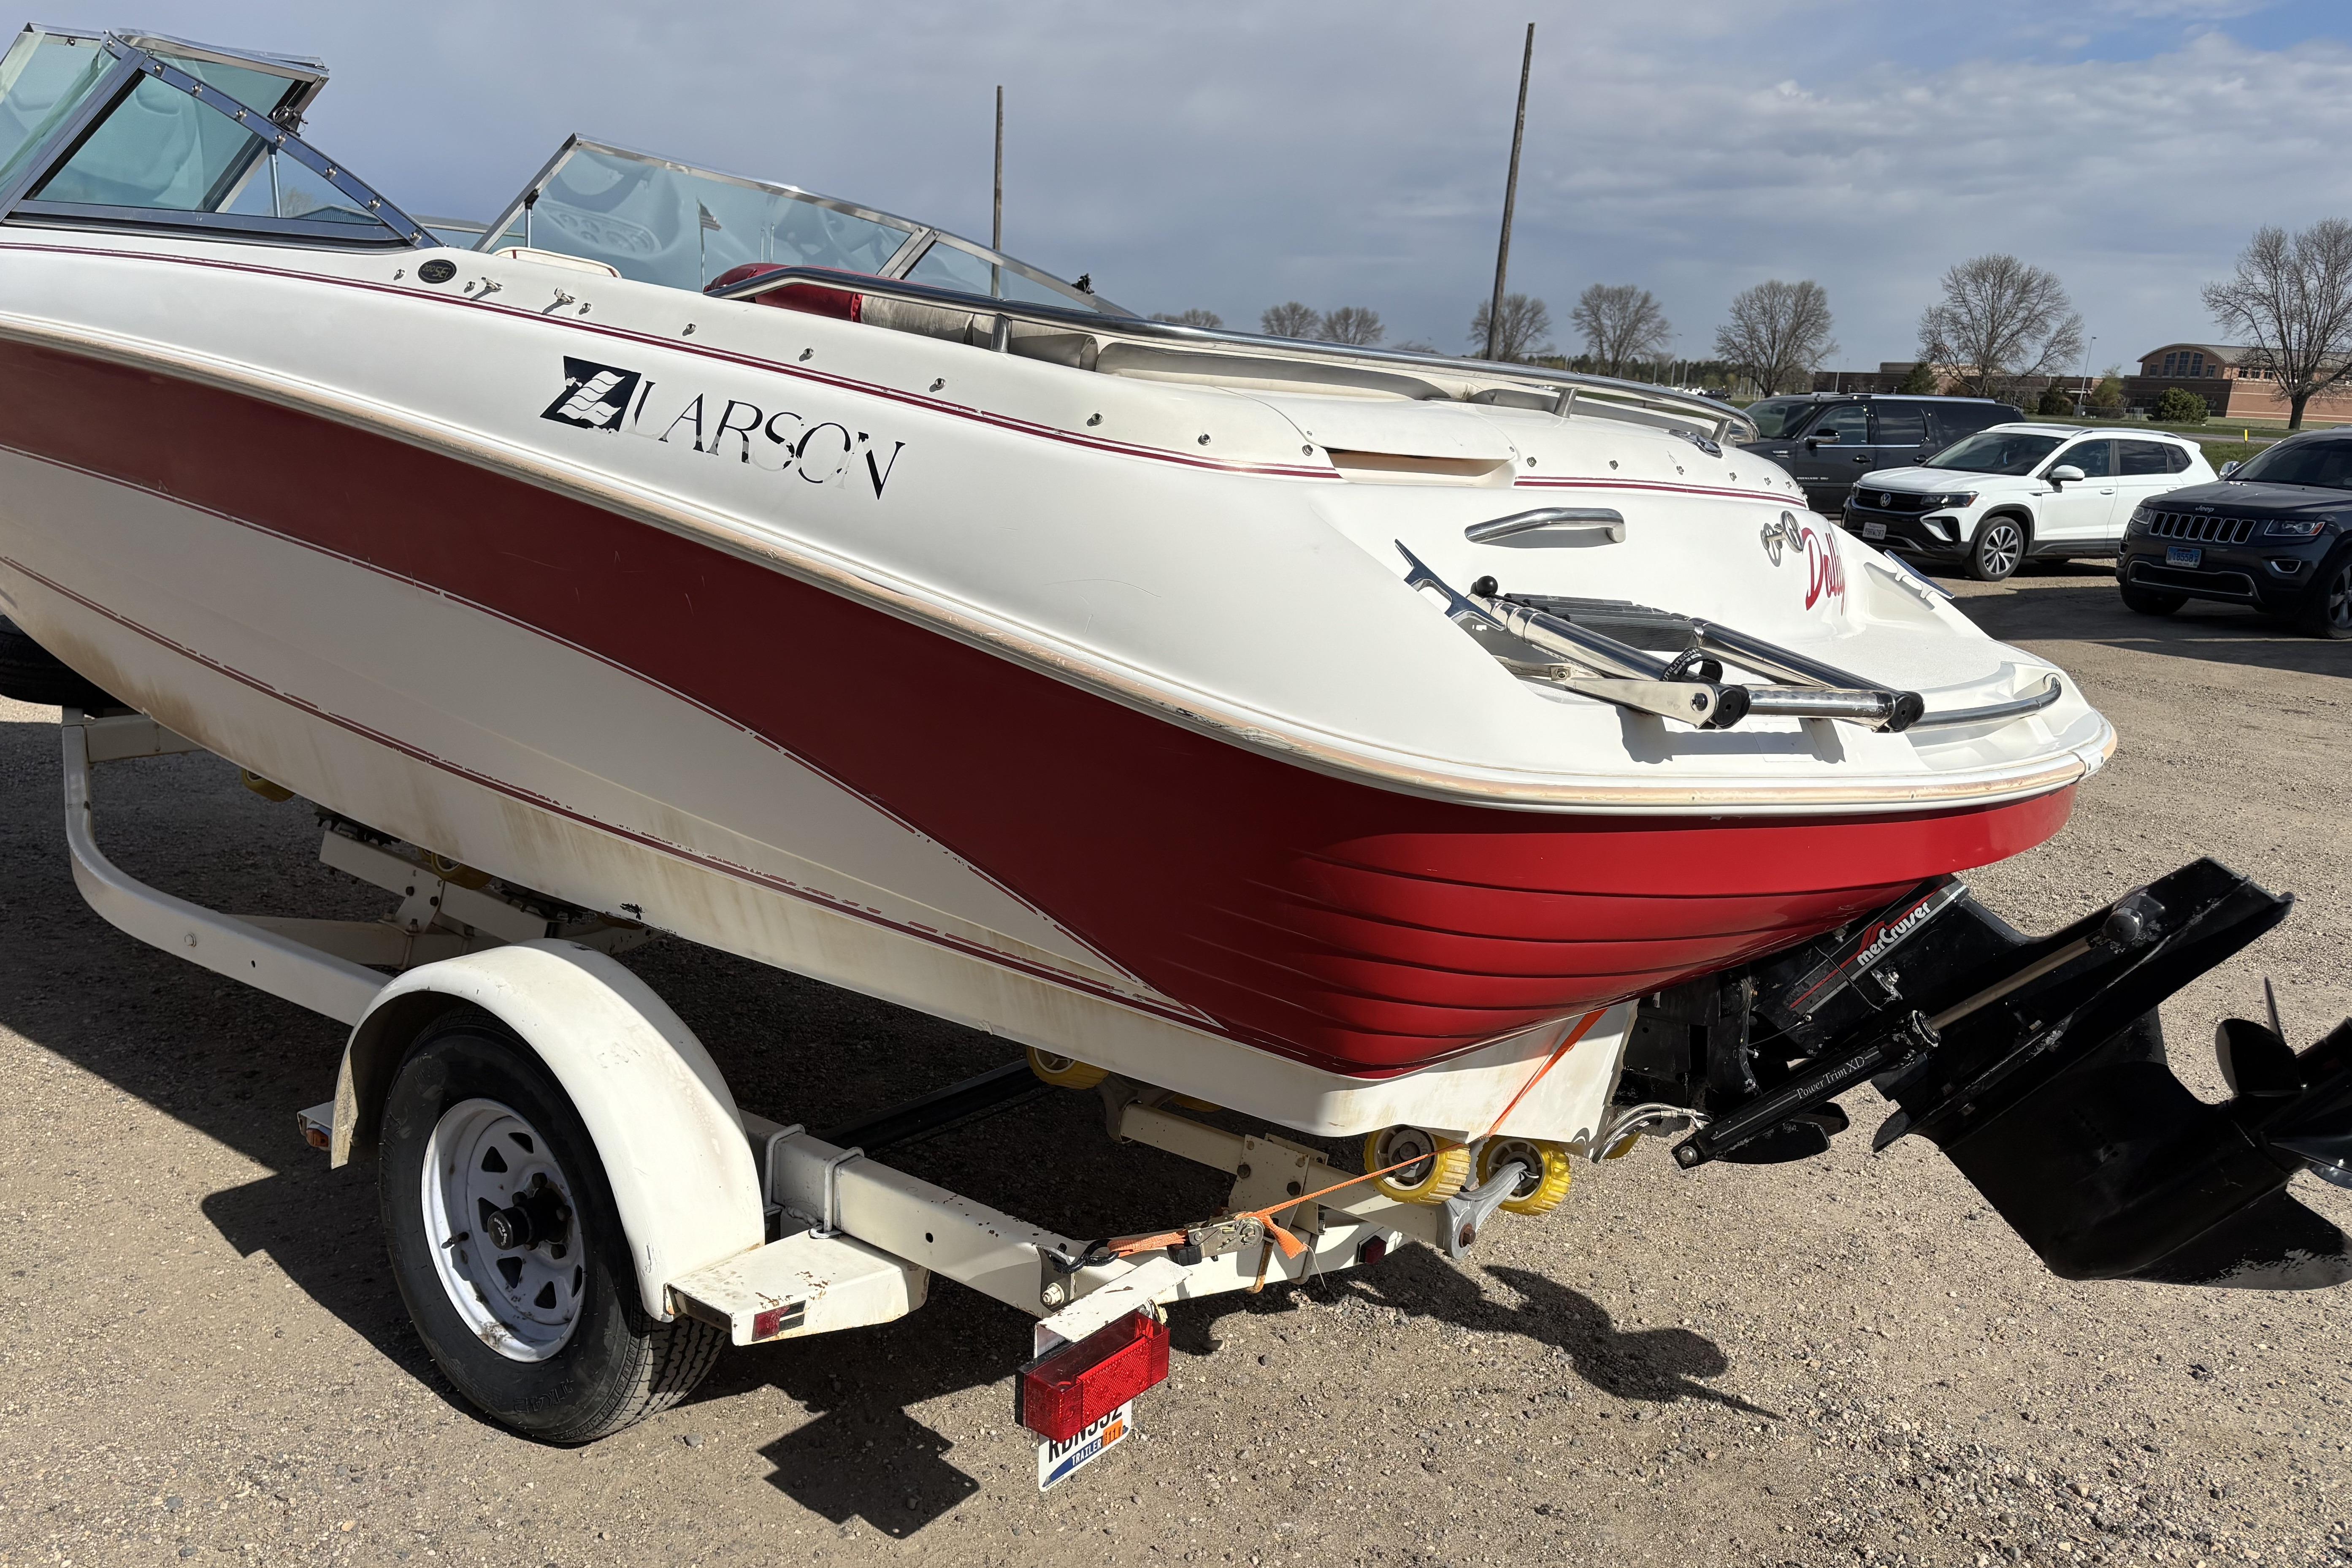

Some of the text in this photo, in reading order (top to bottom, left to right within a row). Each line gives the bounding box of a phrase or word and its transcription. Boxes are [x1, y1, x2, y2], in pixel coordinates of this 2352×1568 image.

[625, 380, 906, 500] LARSON
[1846, 1056, 1865, 1072] XD
[1072, 1438, 1102, 1466] TRAILER
